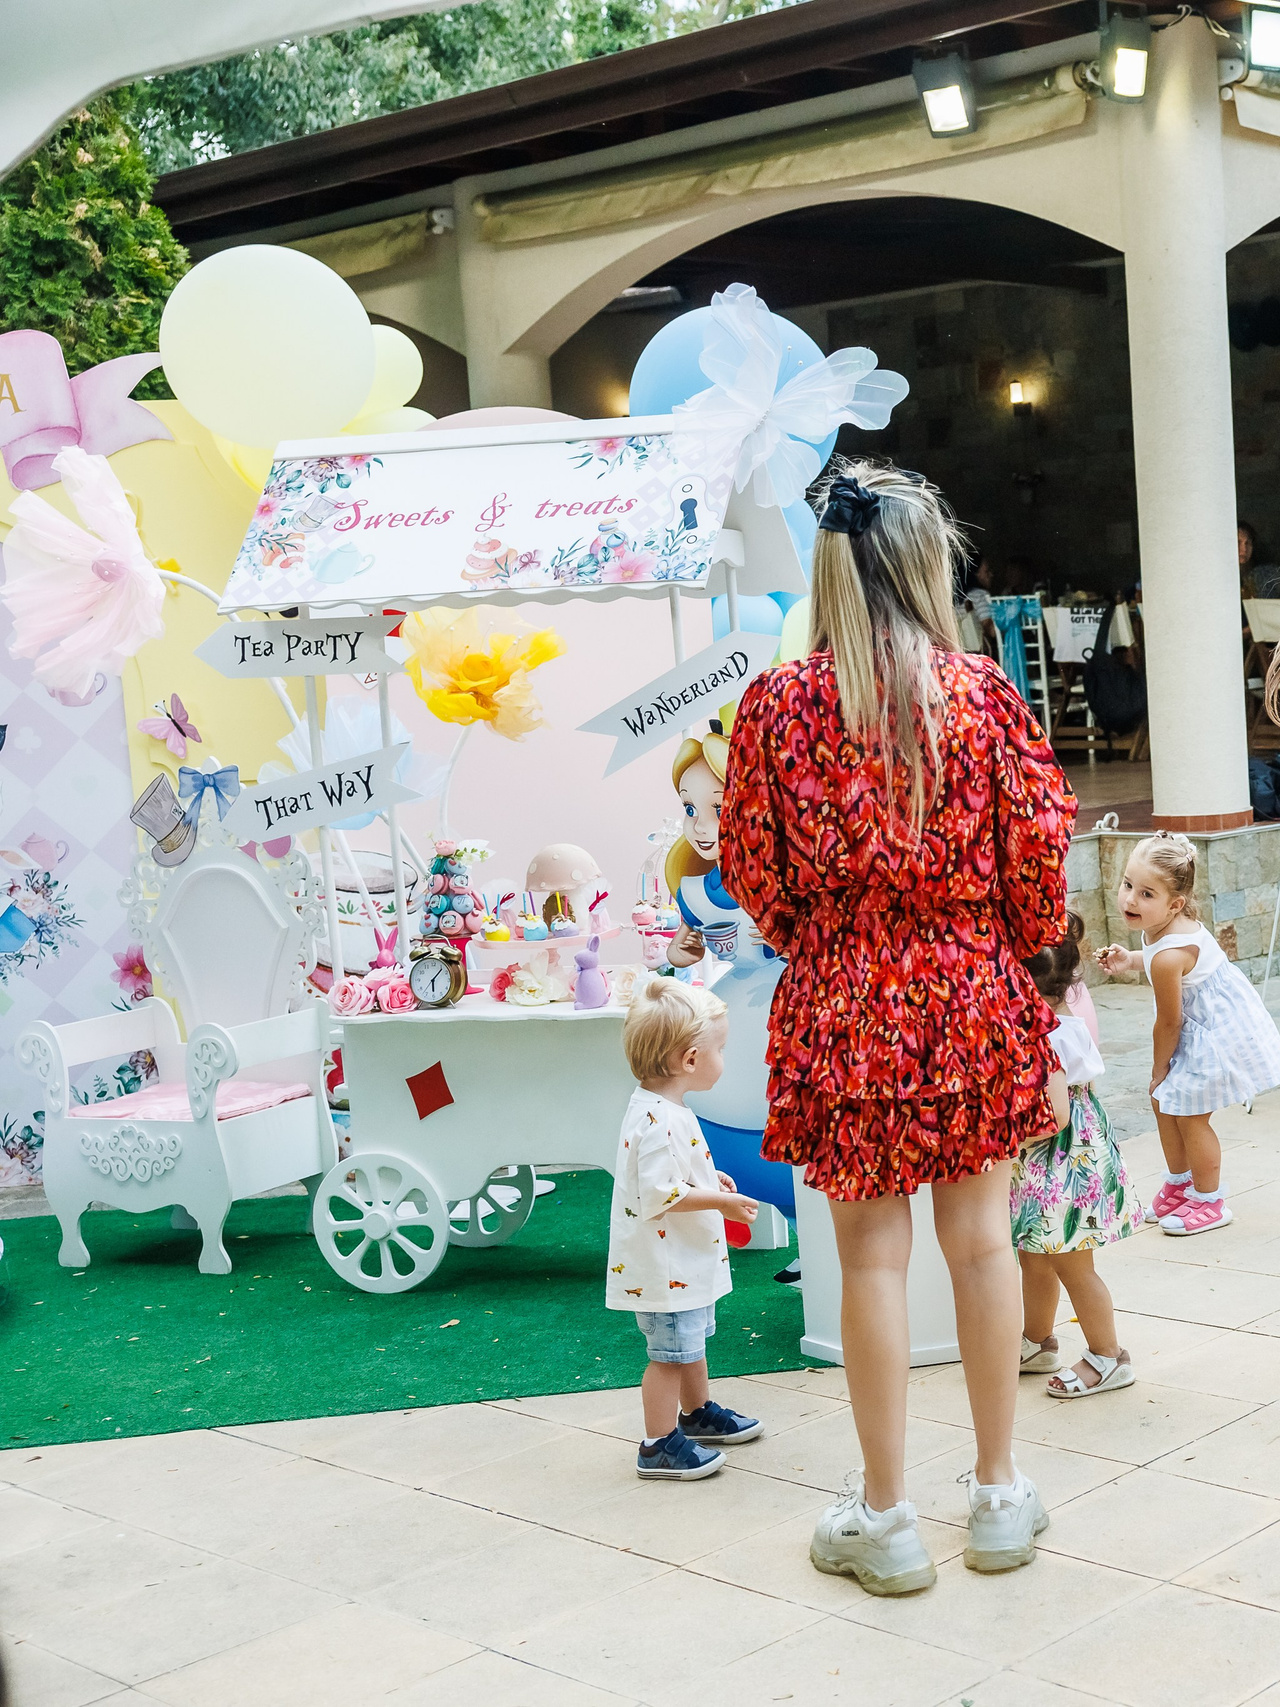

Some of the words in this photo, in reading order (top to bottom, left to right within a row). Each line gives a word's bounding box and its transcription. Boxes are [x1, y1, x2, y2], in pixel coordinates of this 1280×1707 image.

[333, 499, 455, 532] Sweets
[475, 492, 513, 532] &
[534, 494, 638, 520] treats
